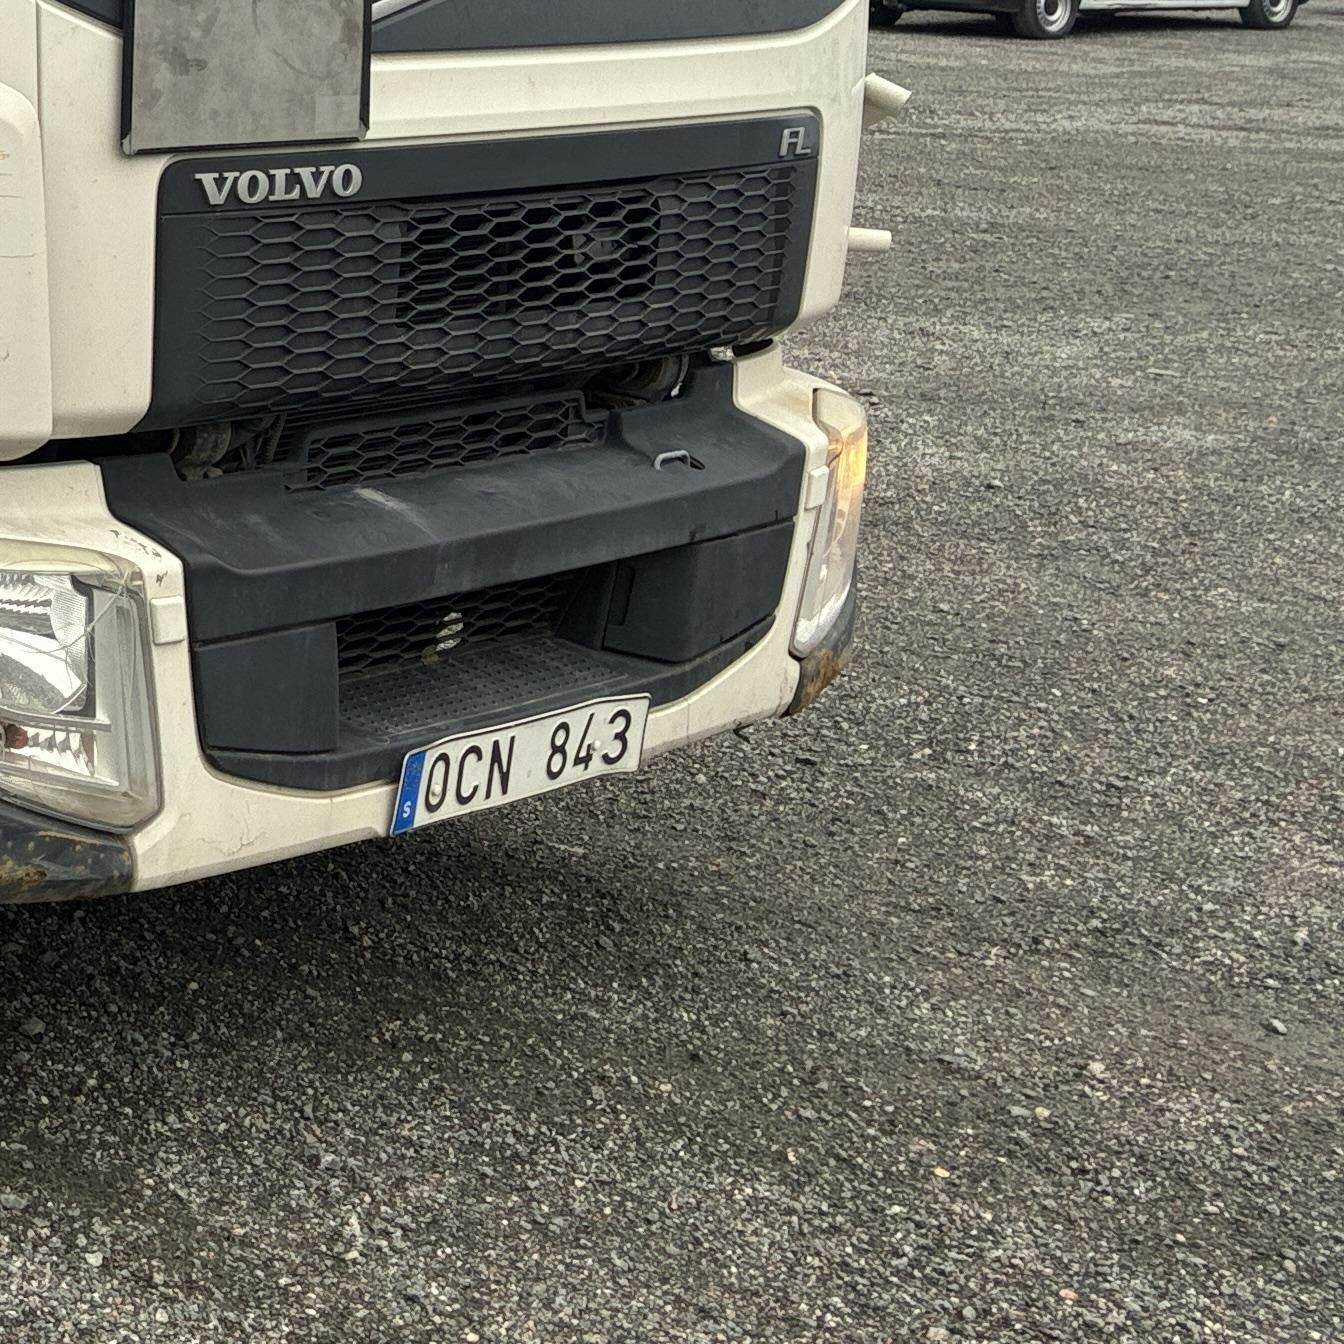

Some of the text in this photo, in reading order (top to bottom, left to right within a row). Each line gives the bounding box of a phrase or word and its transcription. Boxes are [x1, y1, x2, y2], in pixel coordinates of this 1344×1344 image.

[779, 126, 812, 157] FL
[194, 163, 363, 206] VOLVO
[423, 708, 632, 814] OCN 843
[401, 800, 412, 818] S
